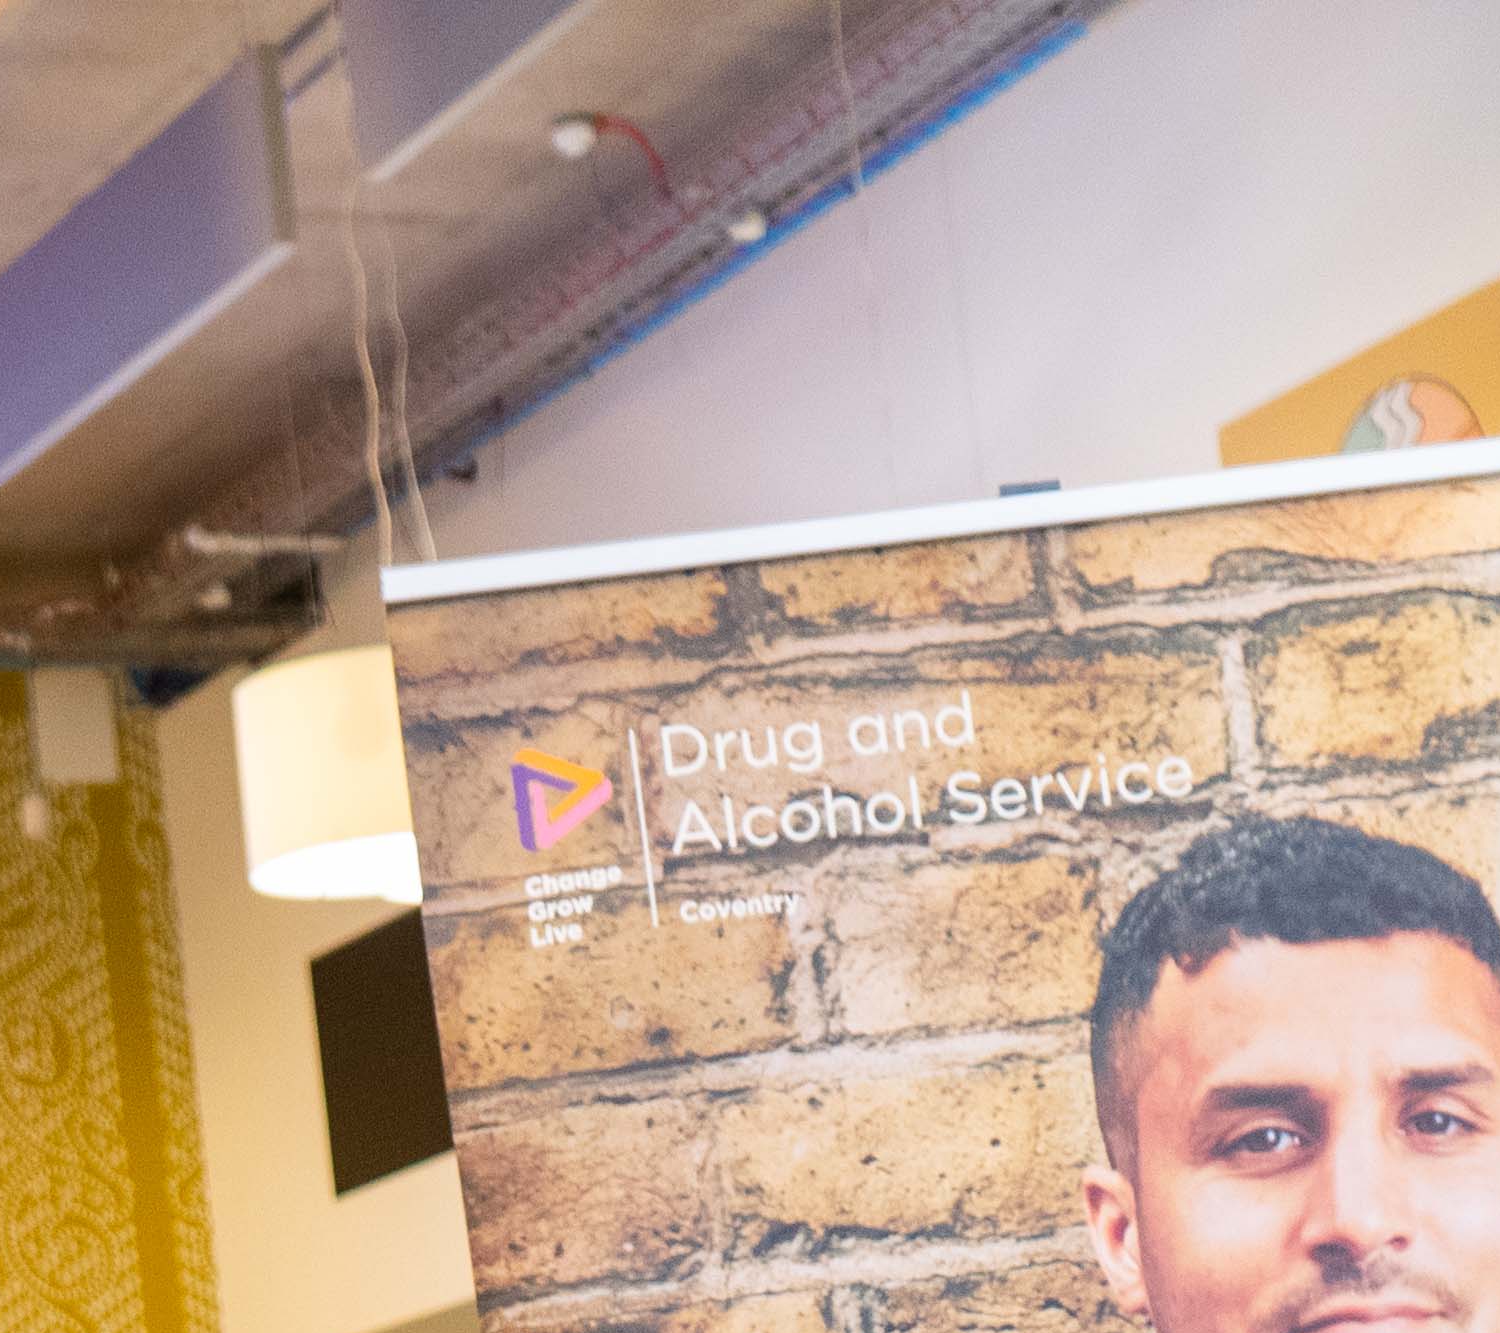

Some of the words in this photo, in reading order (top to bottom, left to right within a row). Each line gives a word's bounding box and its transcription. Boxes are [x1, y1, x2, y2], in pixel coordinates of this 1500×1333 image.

[660, 723, 825, 778] Drug
[848, 690, 976, 757] and
[671, 779, 925, 855] Alcohol
[946, 750, 1194, 826] Service
[524, 864, 623, 897] Change
[527, 894, 594, 922] Grow
[680, 893, 800, 924] Coventry
[531, 922, 583, 949] Live
